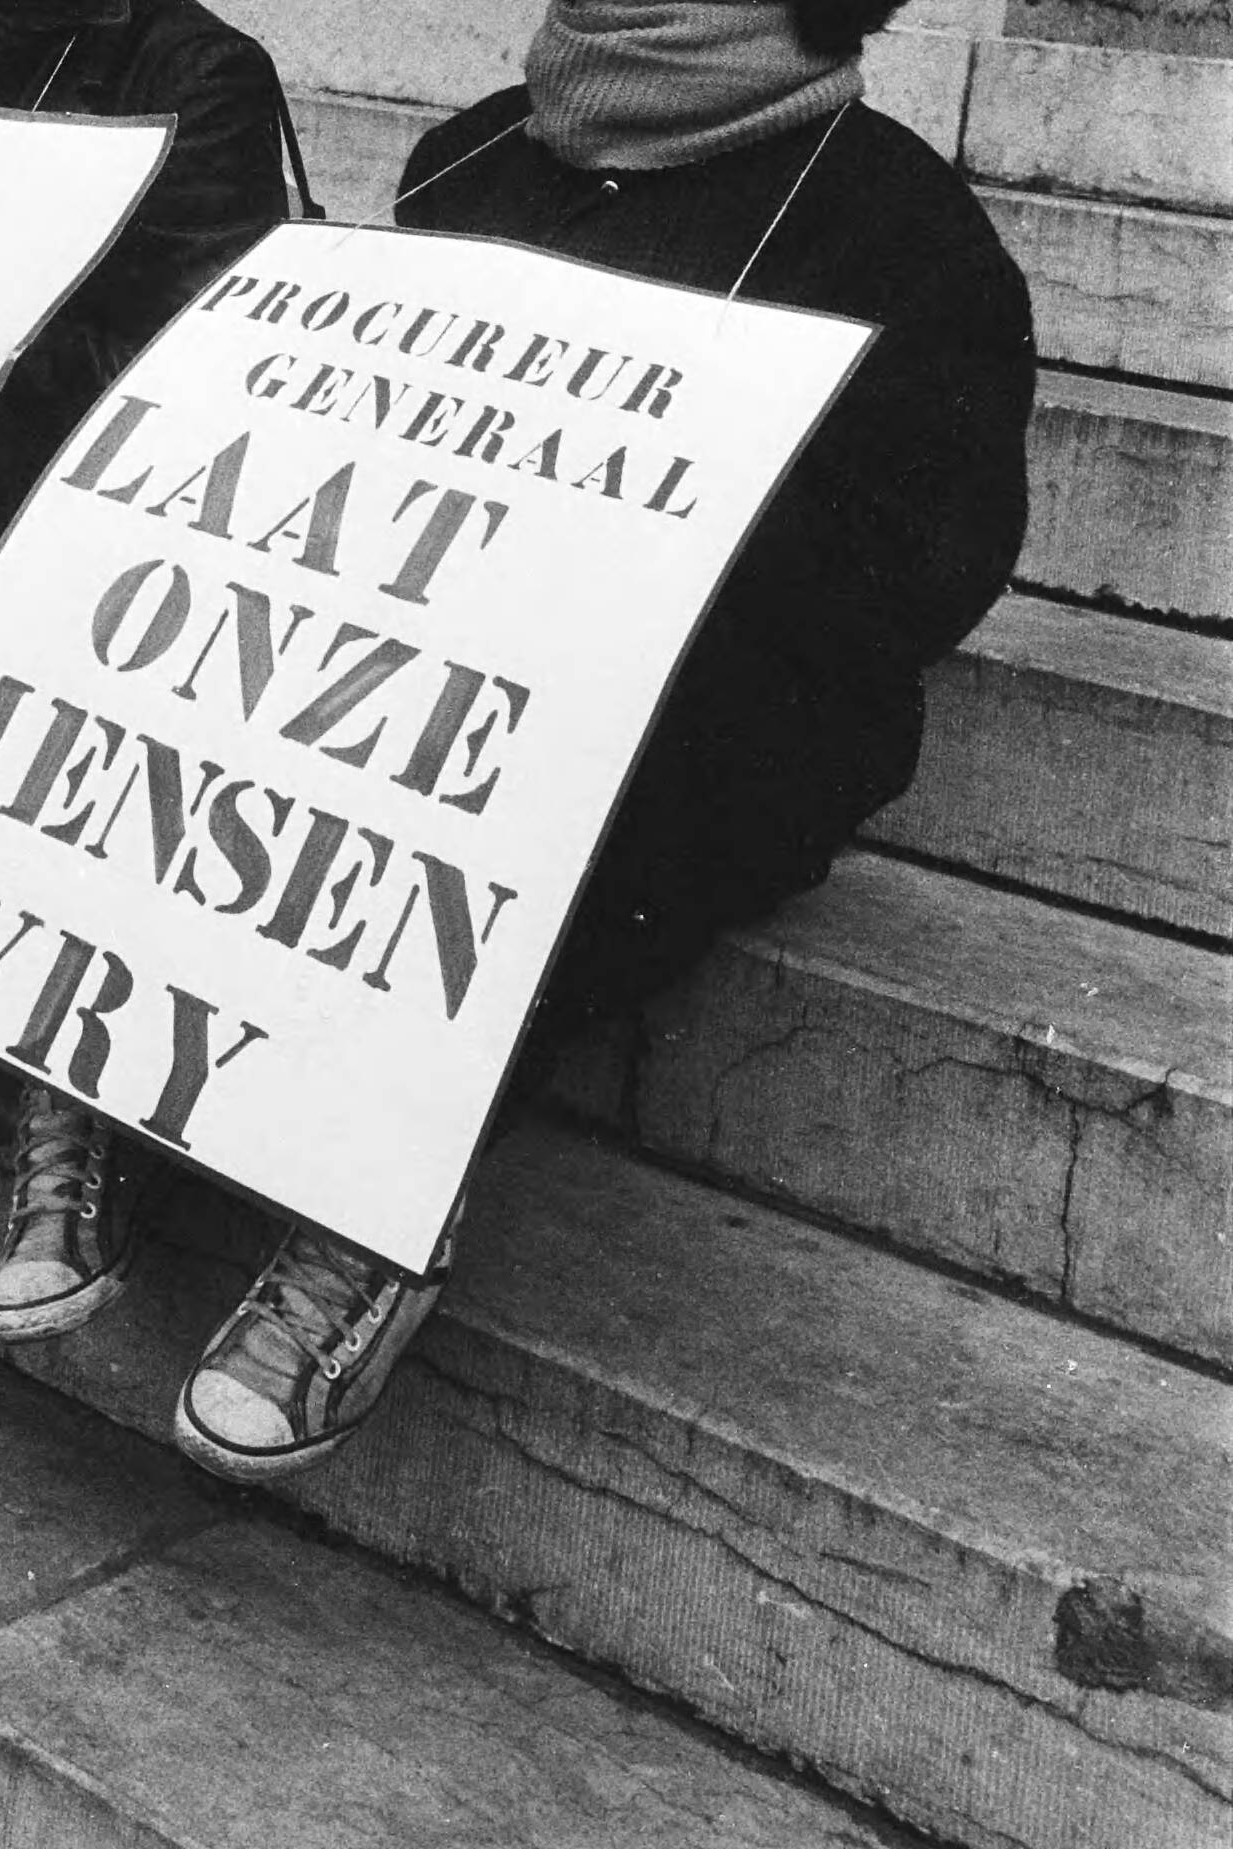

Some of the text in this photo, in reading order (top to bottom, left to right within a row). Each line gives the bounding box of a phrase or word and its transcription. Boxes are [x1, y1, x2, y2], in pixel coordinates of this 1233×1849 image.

[201, 270, 683, 419] PROCUREUR
[247, 354, 696, 519] GENERAAL
[60, 387, 509, 605] LAAT
[93, 560, 530, 816] ONZE
